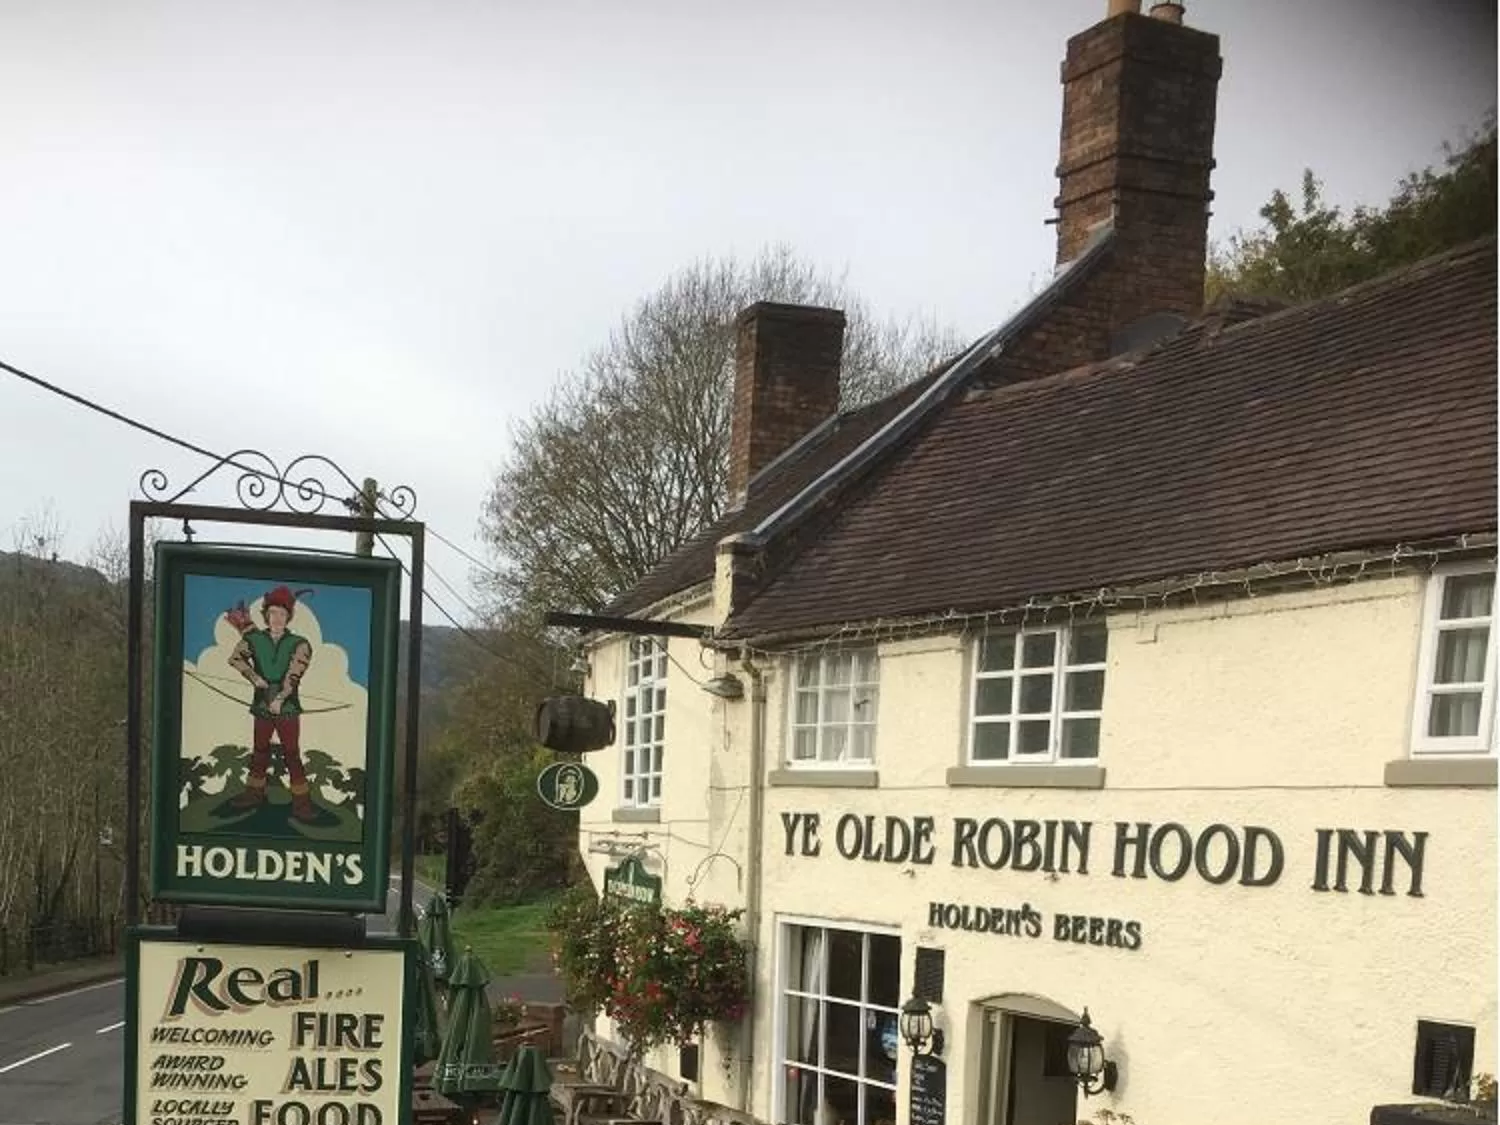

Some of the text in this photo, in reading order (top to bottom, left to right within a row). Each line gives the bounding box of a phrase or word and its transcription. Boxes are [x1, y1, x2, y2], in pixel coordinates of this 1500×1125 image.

[176, 845, 364, 885] HOLDEN'S
[781, 812, 1429, 897] YE OLDE ROBIN HOOD INN
[928, 902, 1142, 949] HOLDEN'S BEERS
[150, 1011, 385, 1049] WELCOMING FIRE
[151, 1055, 225, 1071] AWARD
[284, 1057, 384, 1093] ALES
[149, 1073, 248, 1091] WINNING
[151, 1099, 235, 1117] LOCALLY
